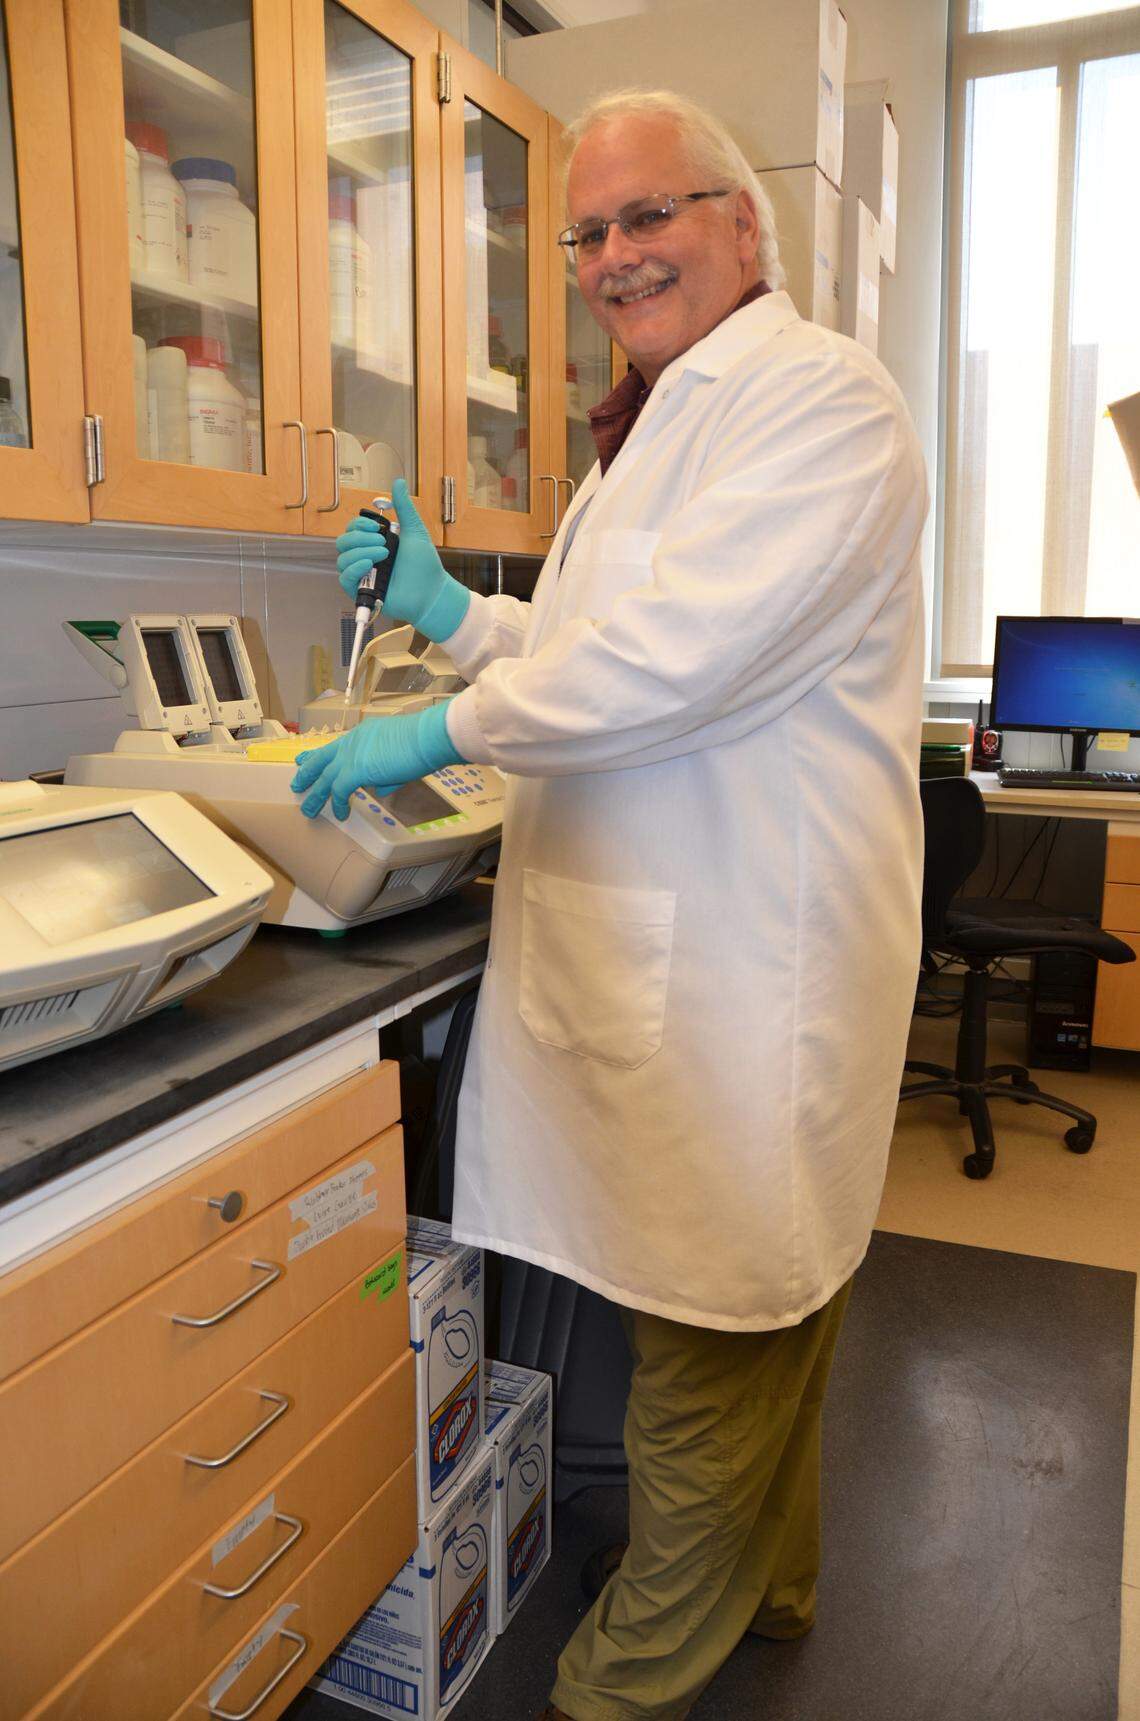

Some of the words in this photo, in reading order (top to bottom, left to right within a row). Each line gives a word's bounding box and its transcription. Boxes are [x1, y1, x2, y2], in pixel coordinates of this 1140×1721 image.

[438, 1394, 473, 1465] CLOROX
[513, 1517, 542, 1578] CLOROX
[446, 1597, 480, 1671] CLOROX
